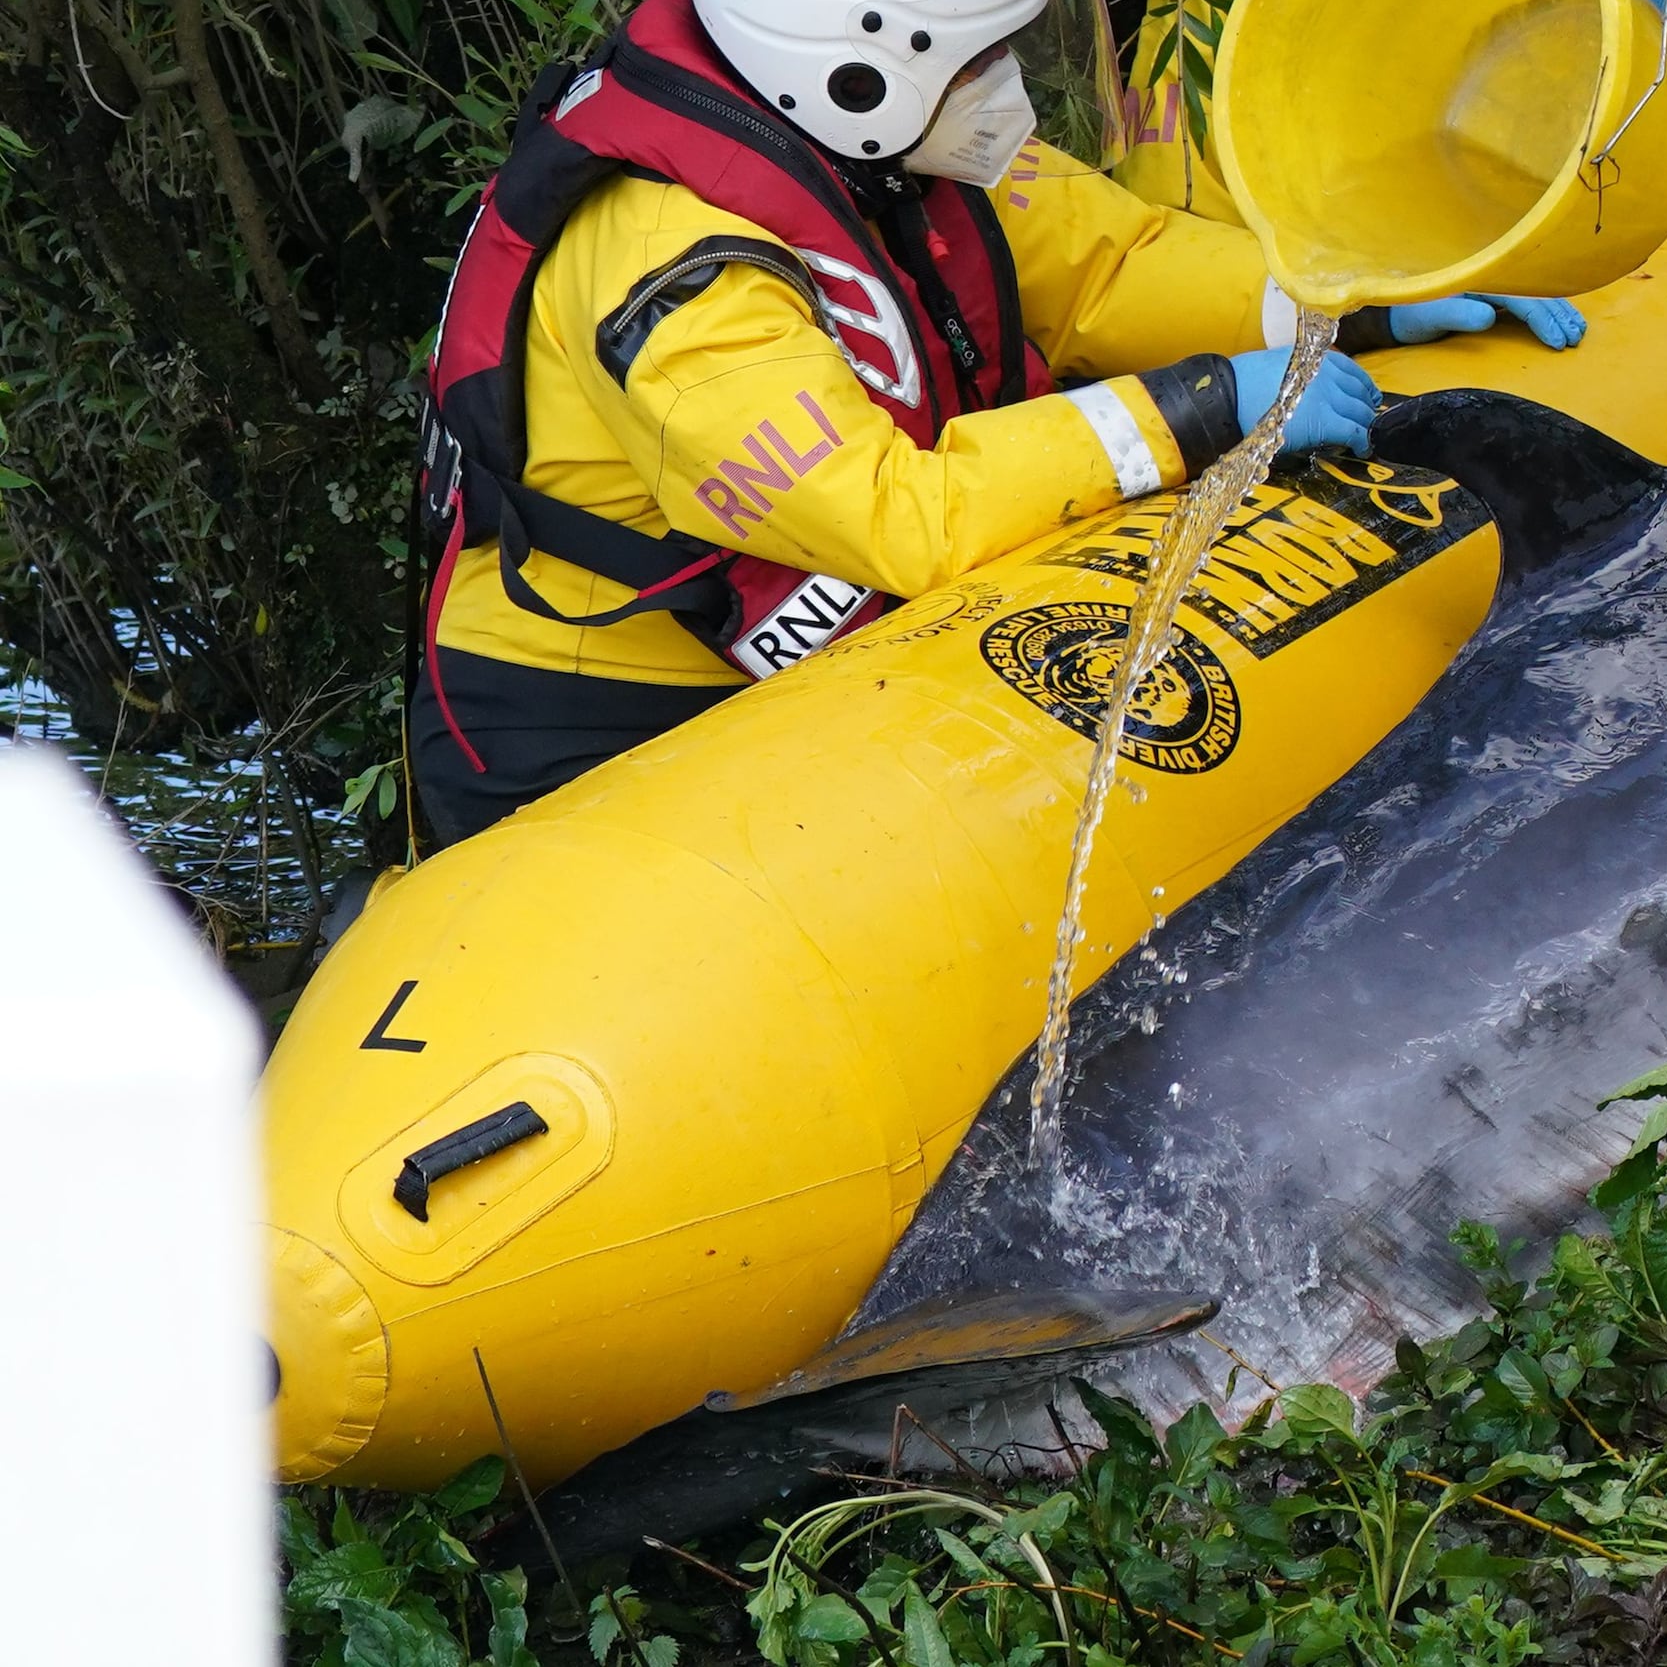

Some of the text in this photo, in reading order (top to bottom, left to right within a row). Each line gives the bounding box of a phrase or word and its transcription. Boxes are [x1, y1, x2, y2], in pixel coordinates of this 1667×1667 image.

[694, 389, 844, 541] RNLI
[956, 581, 1003, 623] PROJECT
[1190, 495, 1397, 634] BORN
[1053, 620, 1111, 634] 01634
[986, 604, 1237, 770] BRITISH DIVER RINE LIFE RESCUE
[359, 979, 428, 1054] L
